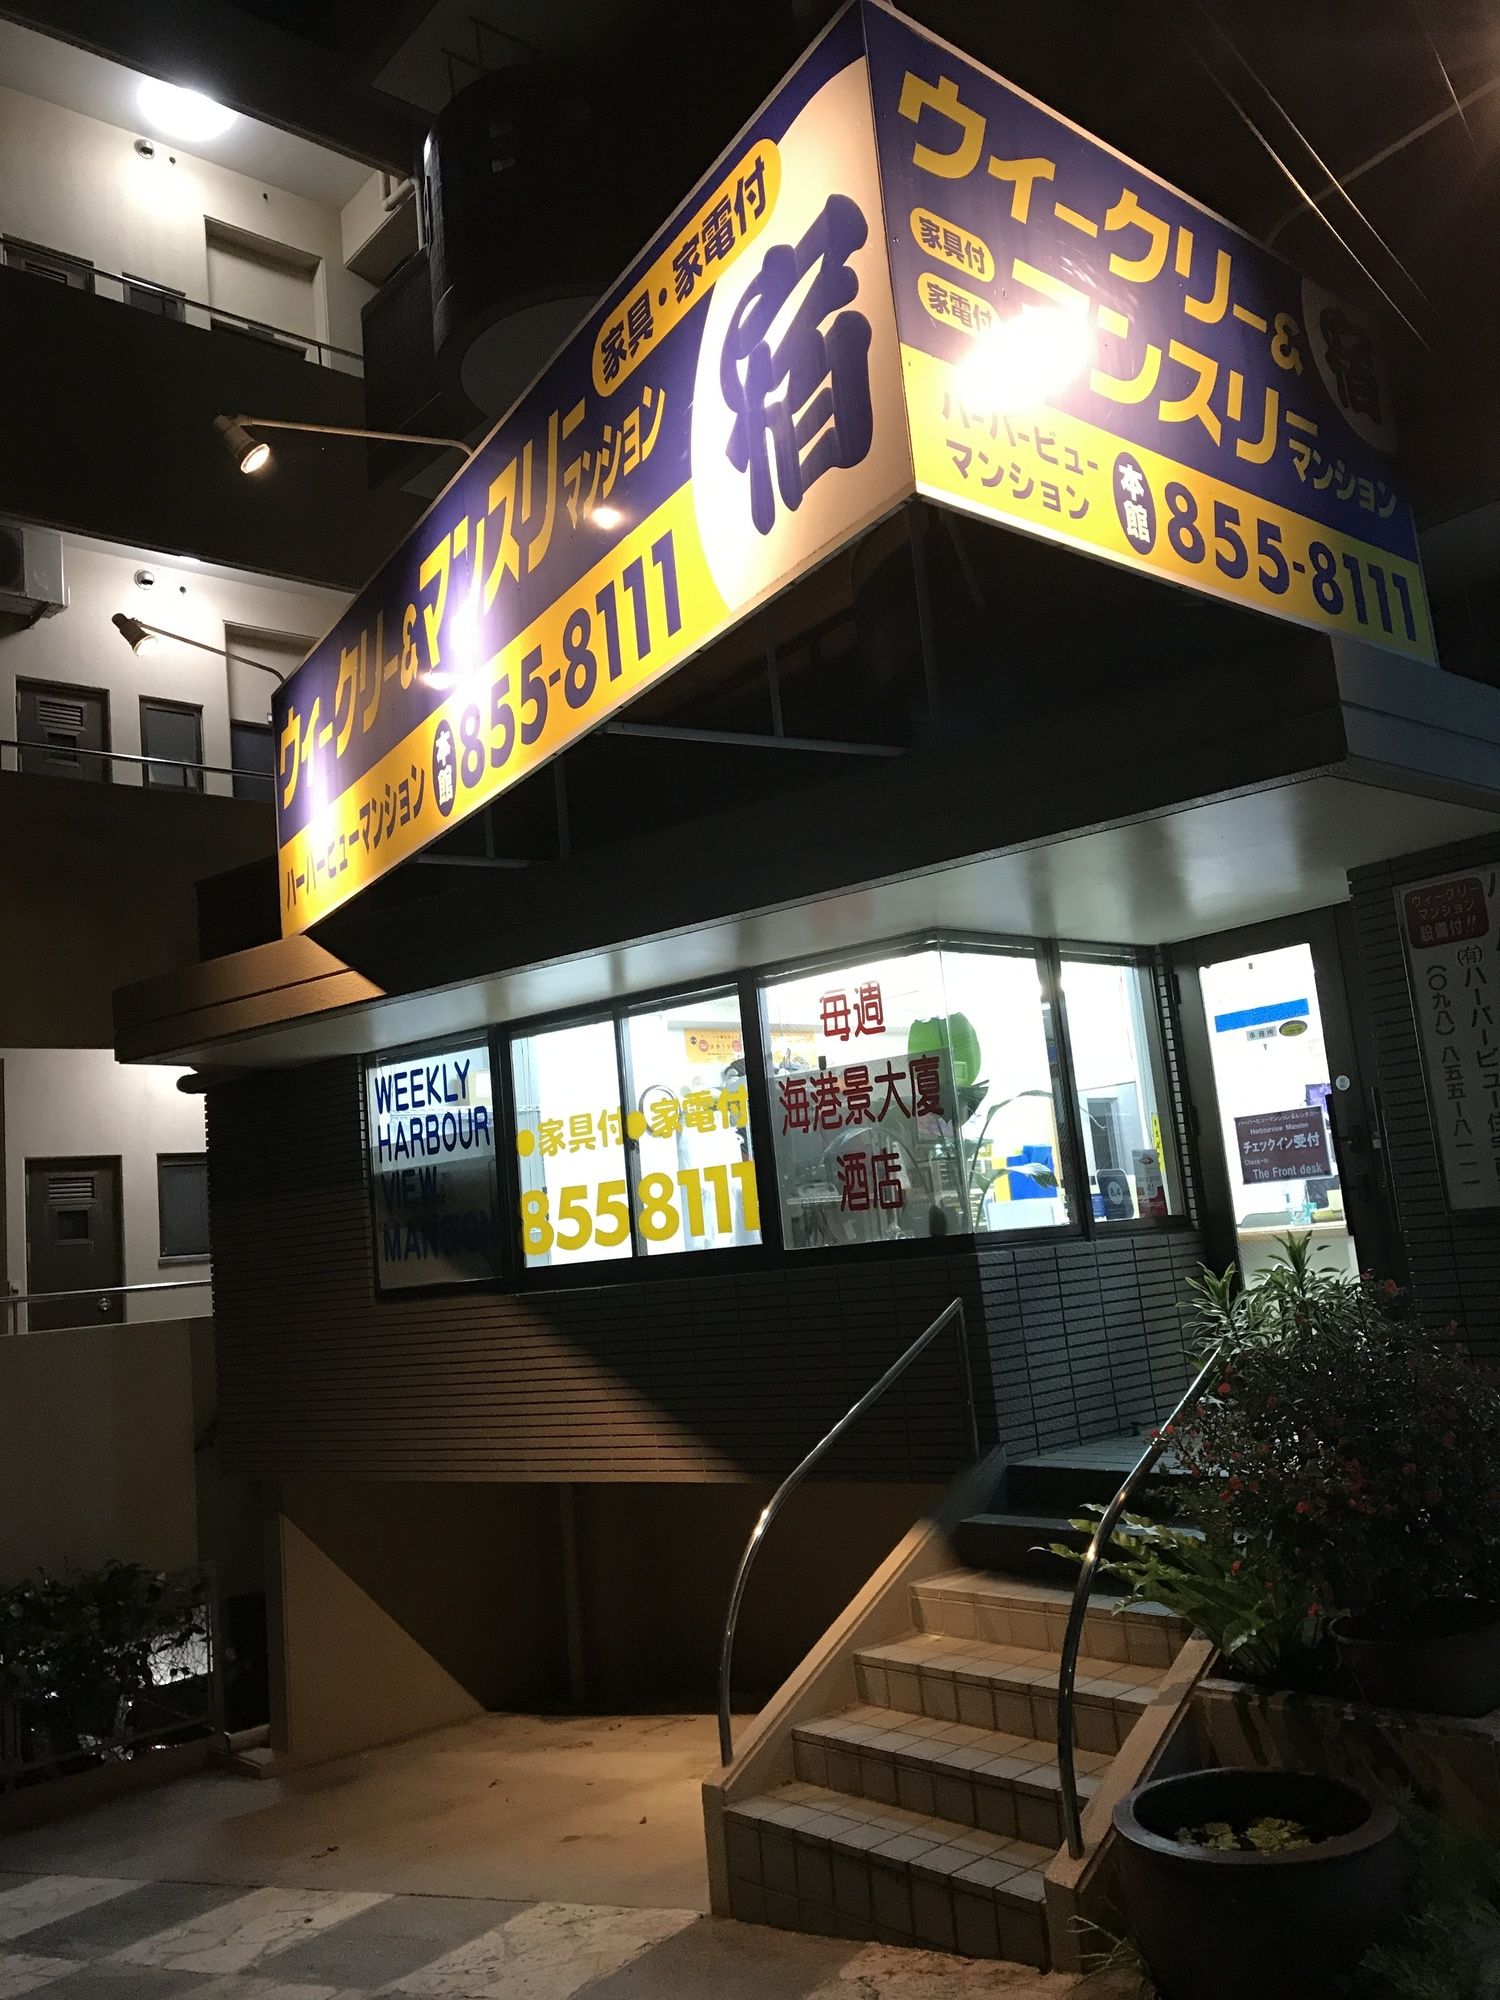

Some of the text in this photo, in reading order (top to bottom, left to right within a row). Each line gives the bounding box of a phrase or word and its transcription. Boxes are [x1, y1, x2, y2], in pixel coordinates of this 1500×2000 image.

[601, 155, 767, 385] 家具・家電付
[919, 216, 985, 275] 家具付
[926, 281, 993, 332] 家電付
[945, 438, 1090, 520] マンション
[1288, 438, 1398, 519] マンション
[1116, 462, 1419, 642] 本館 855-8111
[434, 728, 455, 806] 本館
[459, 528, 683, 790] 855-8111
[1411, 885, 1479, 909] ウィークリー
[1418, 900, 1475, 921] マンション
[374, 1058, 471, 1115] WEEKLY
[778, 1054, 945, 1136] 海港景大廈
[377, 1105, 491, 1164] HARBOUR
[538, 1084, 749, 1156] 家具付 家電付
[1242, 1131, 1321, 1155] チェックイン受付
[380, 1165, 438, 1212] VIEW
[836, 1148, 904, 1213] 酒店
[1252, 1161, 1323, 1180] The Front desk
